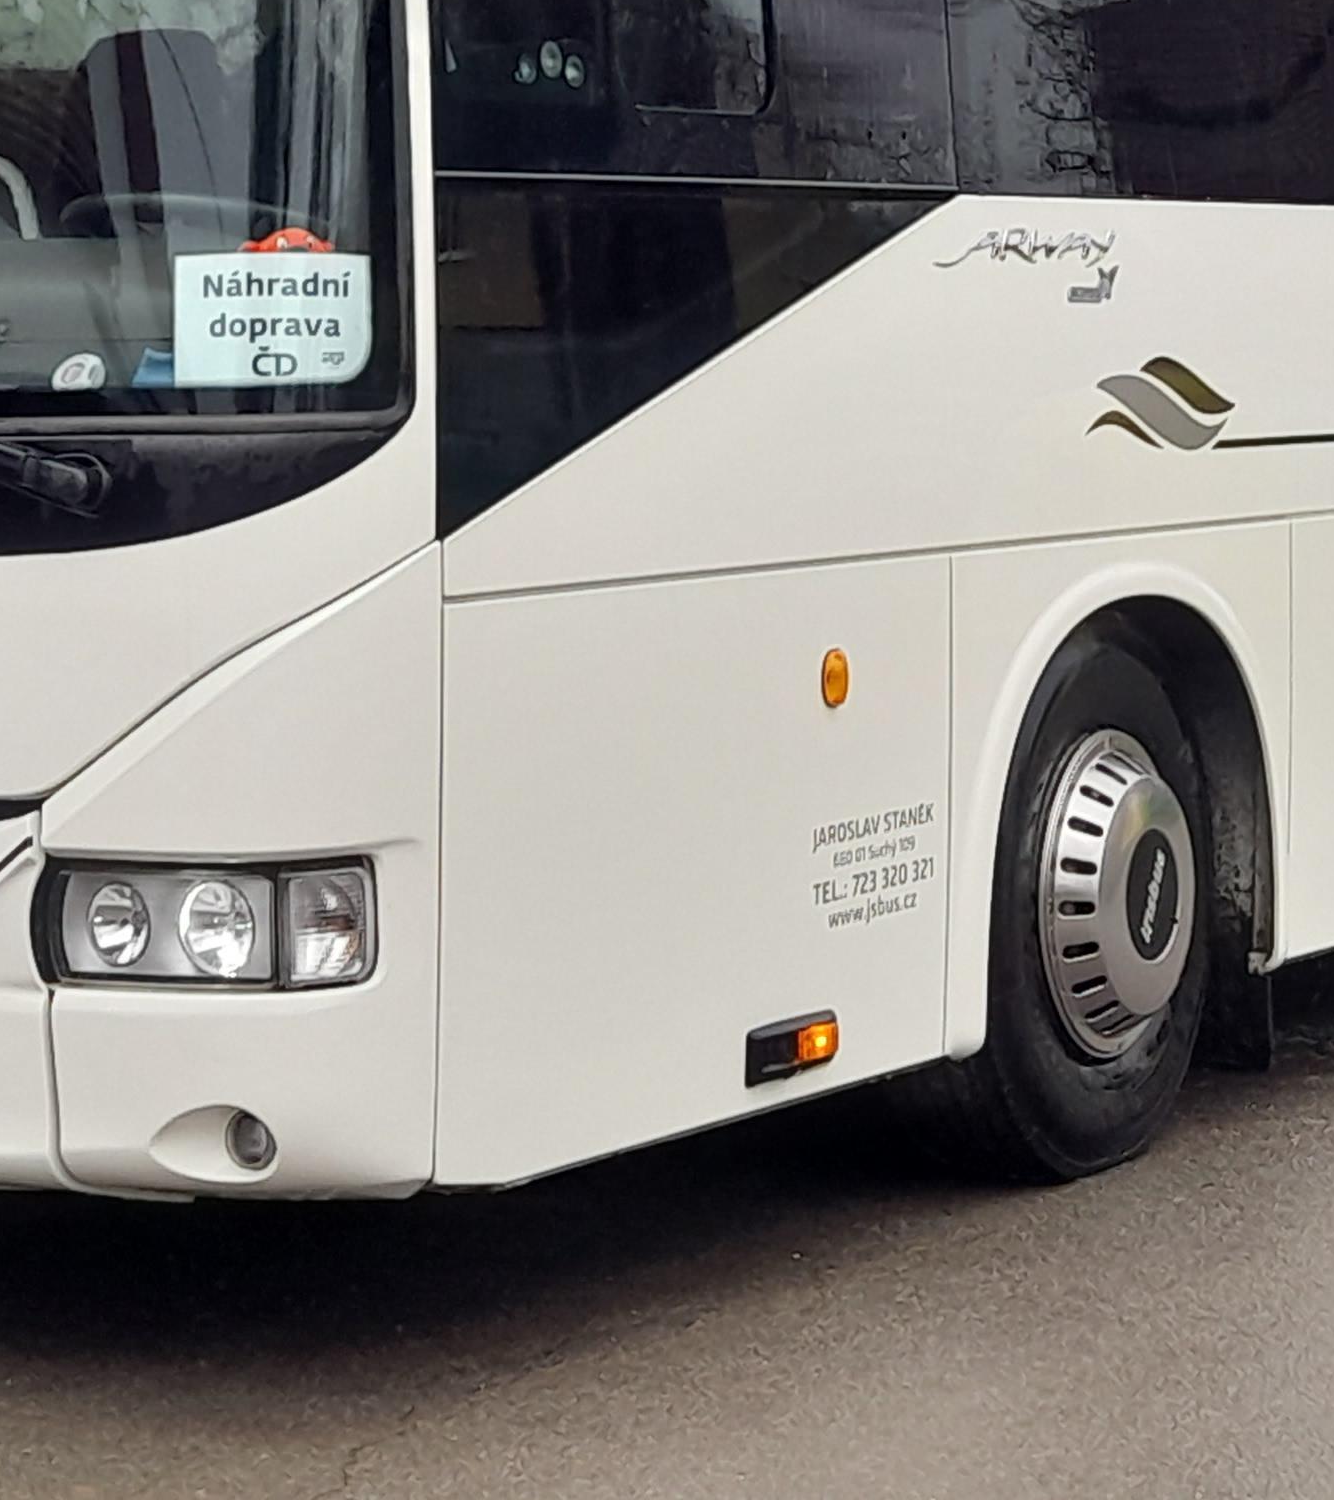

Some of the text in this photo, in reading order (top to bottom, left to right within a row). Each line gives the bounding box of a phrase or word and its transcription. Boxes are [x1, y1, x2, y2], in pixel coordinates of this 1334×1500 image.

[203, 270, 352, 298] Náhradní
[208, 312, 341, 343] doprava
[251, 346, 299, 377] ČD
[812, 813, 881, 854] JAROSLAV
[852, 869, 877, 897] 723
[881, 862, 908, 890] 320
[911, 856, 934, 883] 321
[828, 892, 917, 929] www.jsbus.cz
